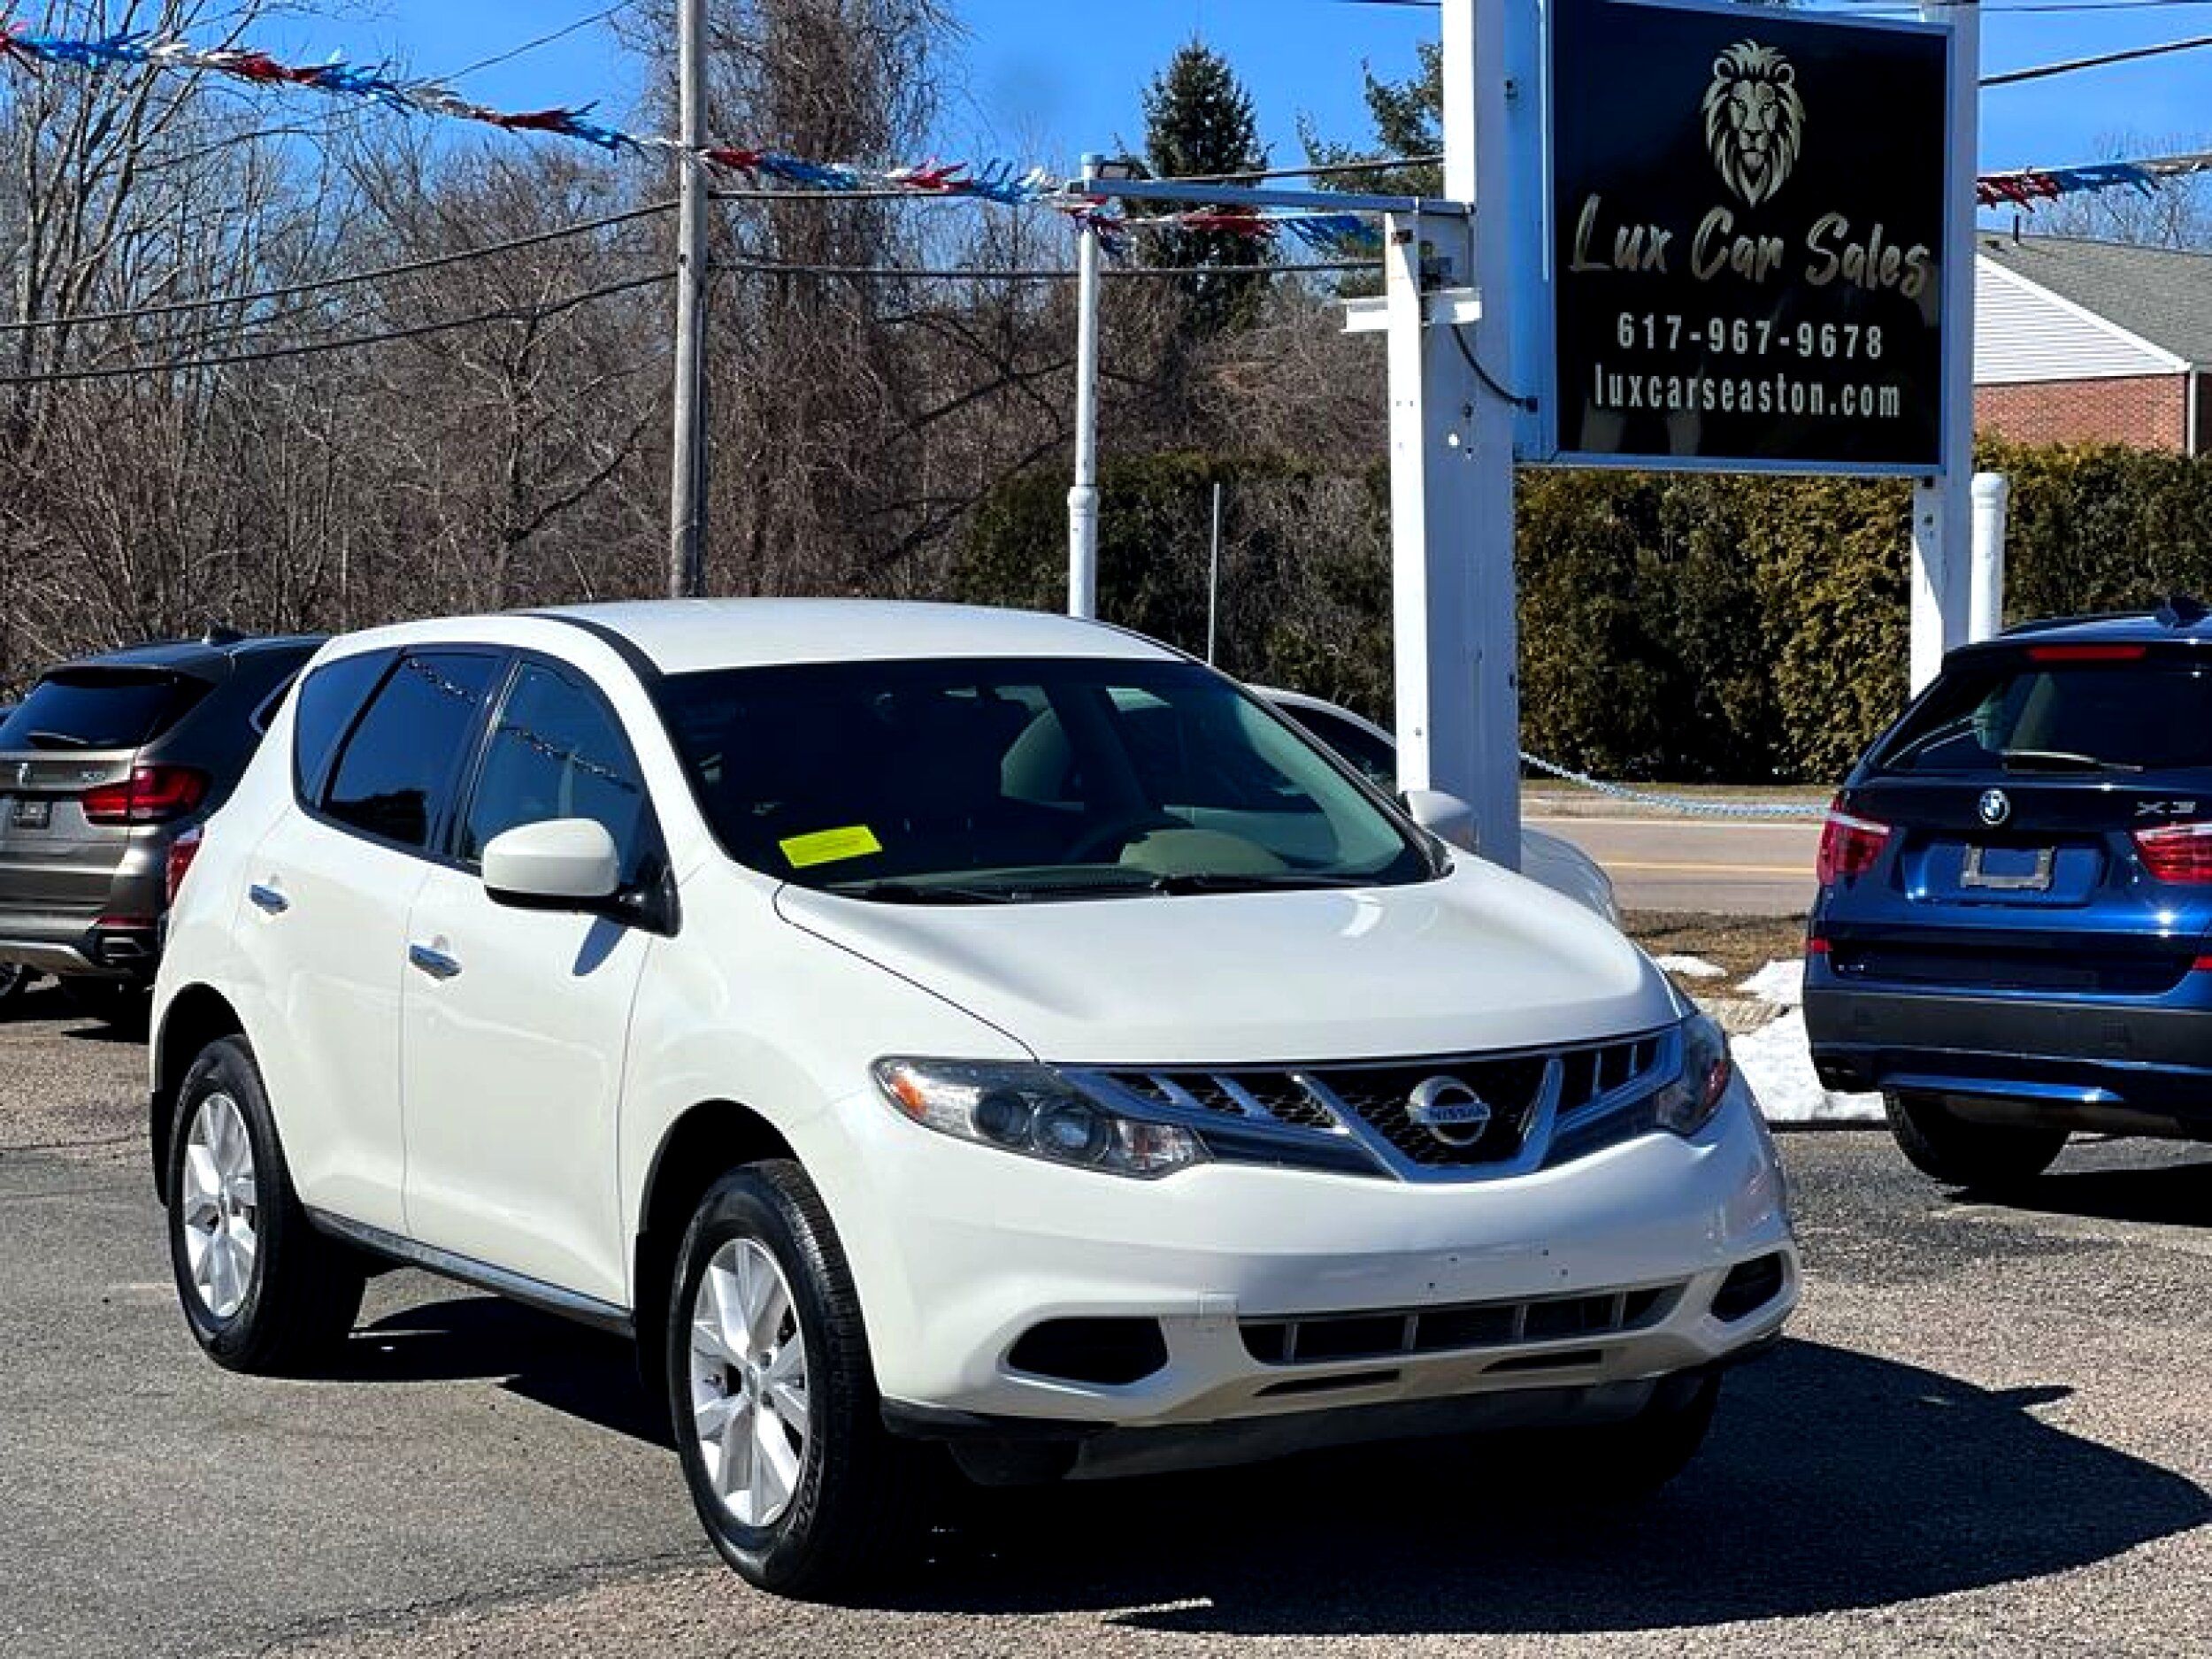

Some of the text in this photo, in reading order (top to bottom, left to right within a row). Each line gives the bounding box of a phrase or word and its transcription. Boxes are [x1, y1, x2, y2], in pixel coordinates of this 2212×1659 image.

[1570, 194, 1931, 297] Lux Car Sales
[1618, 313, 1883, 358] 617-967-9678
[1594, 364, 1900, 418] luxcarseaston.com
[2135, 801, 2196, 816] X3
